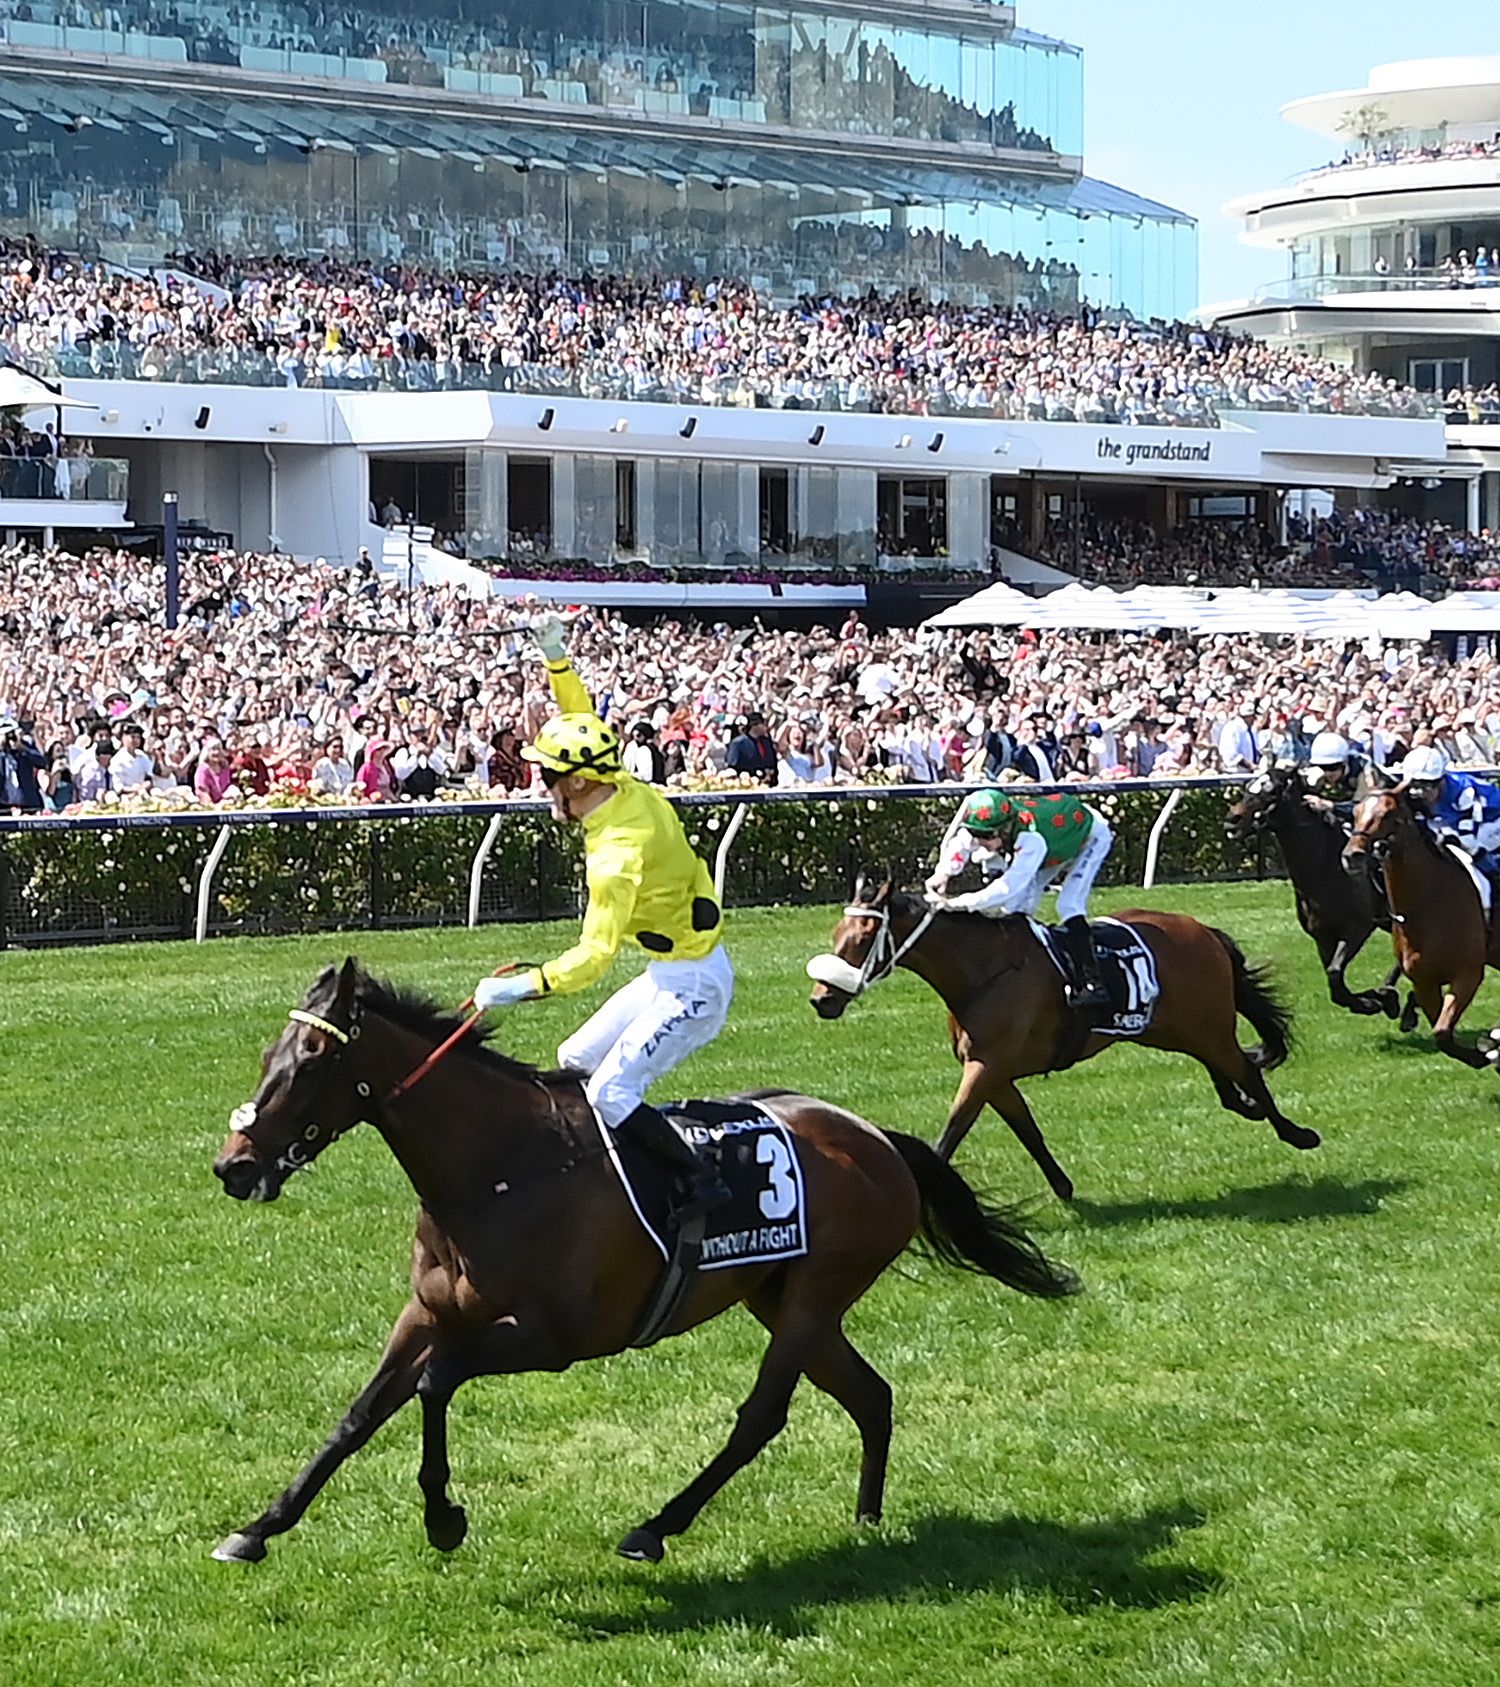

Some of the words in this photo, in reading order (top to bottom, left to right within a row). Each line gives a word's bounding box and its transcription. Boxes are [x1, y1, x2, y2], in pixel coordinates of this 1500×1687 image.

[1098, 437, 1121, 458] the
[1126, 440, 1210, 465] grandstand
[756, 1134, 797, 1219] 3
